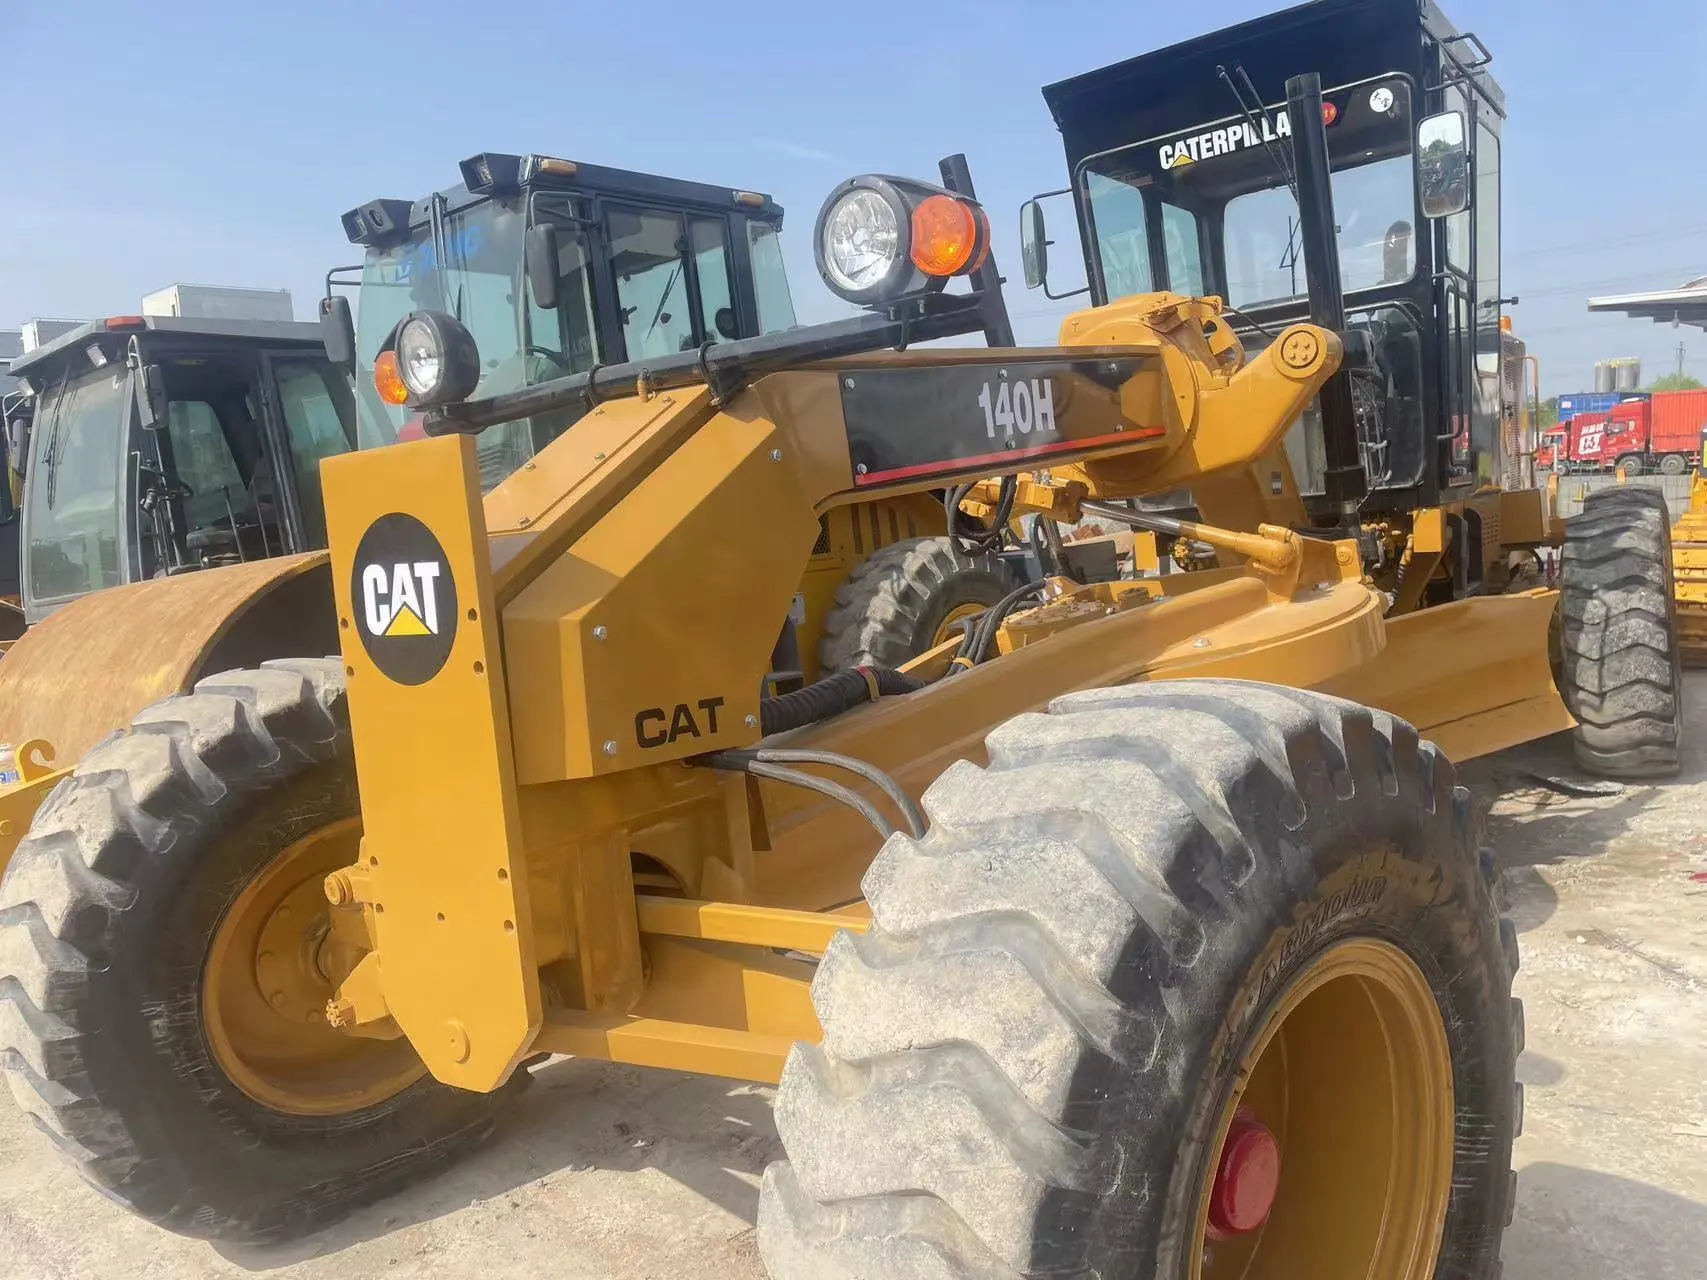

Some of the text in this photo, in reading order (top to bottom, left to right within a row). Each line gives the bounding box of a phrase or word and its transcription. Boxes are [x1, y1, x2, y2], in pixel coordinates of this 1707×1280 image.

[1158, 111, 1292, 170] CATERPILLA
[978, 378, 1056, 438] 140H
[362, 562, 440, 636] CAT
[635, 696, 724, 748] CAT
